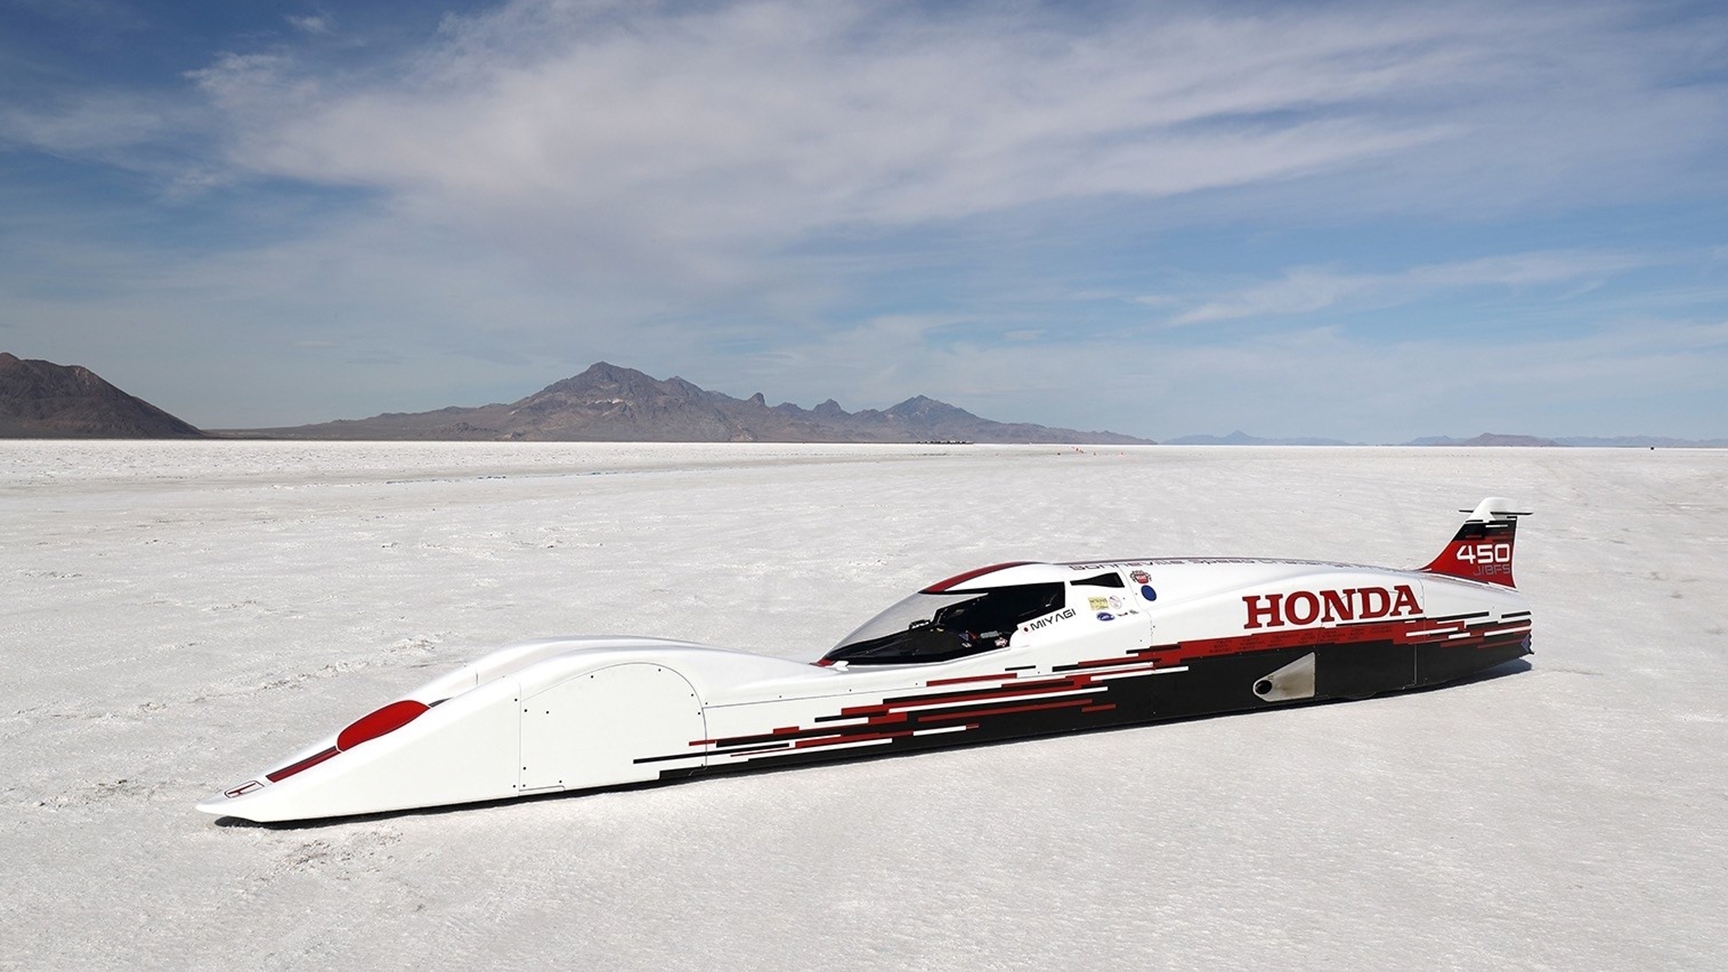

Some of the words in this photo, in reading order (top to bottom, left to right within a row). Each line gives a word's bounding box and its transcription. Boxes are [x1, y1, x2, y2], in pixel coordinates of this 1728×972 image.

[1456, 543, 1511, 564] 450
[1242, 584, 1423, 630] HONDA
[1029, 608, 1077, 632] MIYAGI
